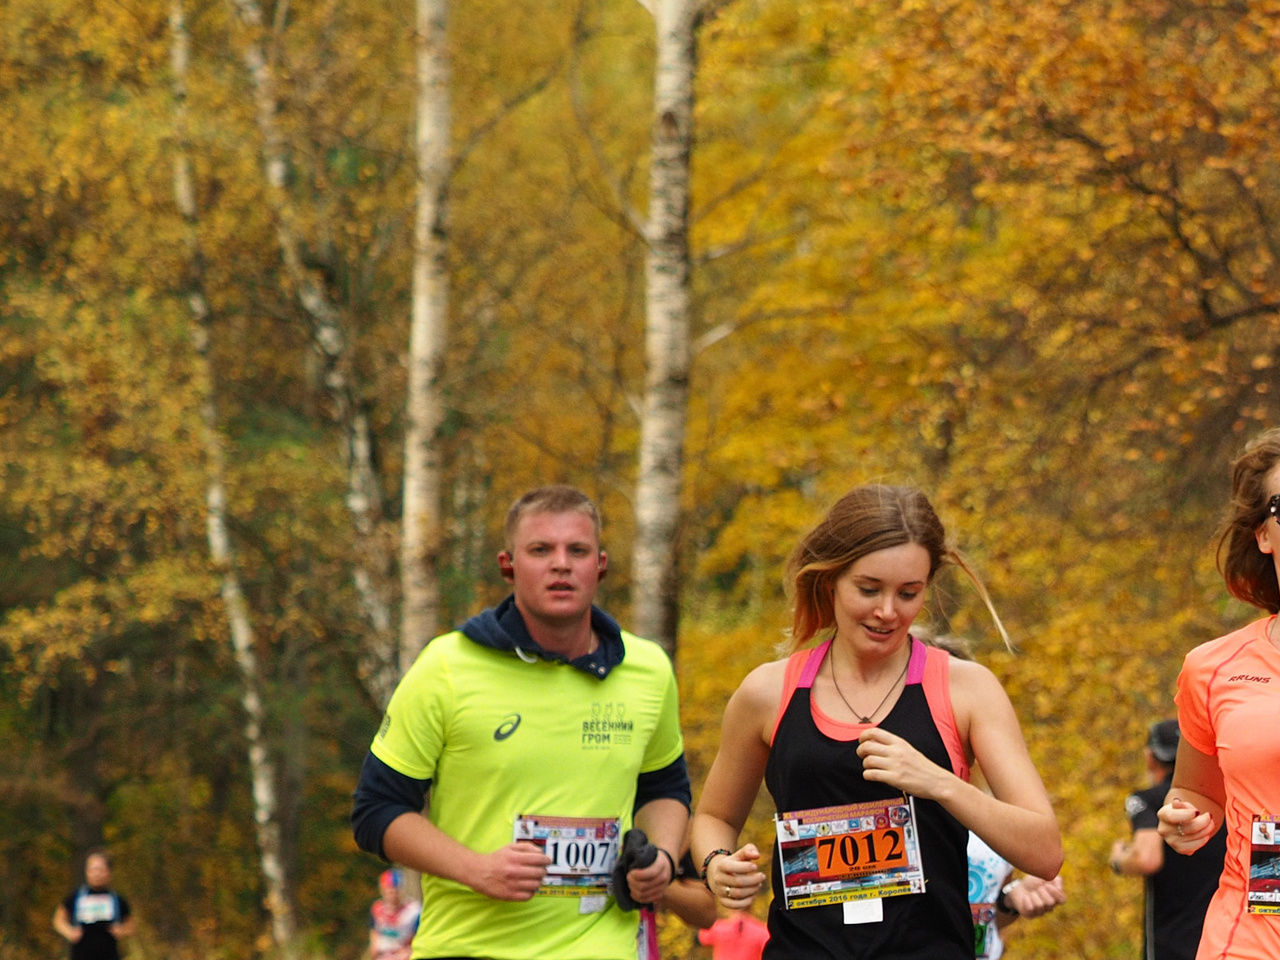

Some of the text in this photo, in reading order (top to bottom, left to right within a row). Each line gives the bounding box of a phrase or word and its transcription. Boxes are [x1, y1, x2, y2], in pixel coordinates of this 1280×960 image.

[1228, 675, 1271, 683] RRUNS
[582, 734, 610, 744] ГРОМ
[551, 842, 610, 868] 1007
[818, 830, 902, 869] 7012
[796, 897, 827, 907] октября
[829, 894, 848, 903] 2016
[850, 892, 868, 901] года
